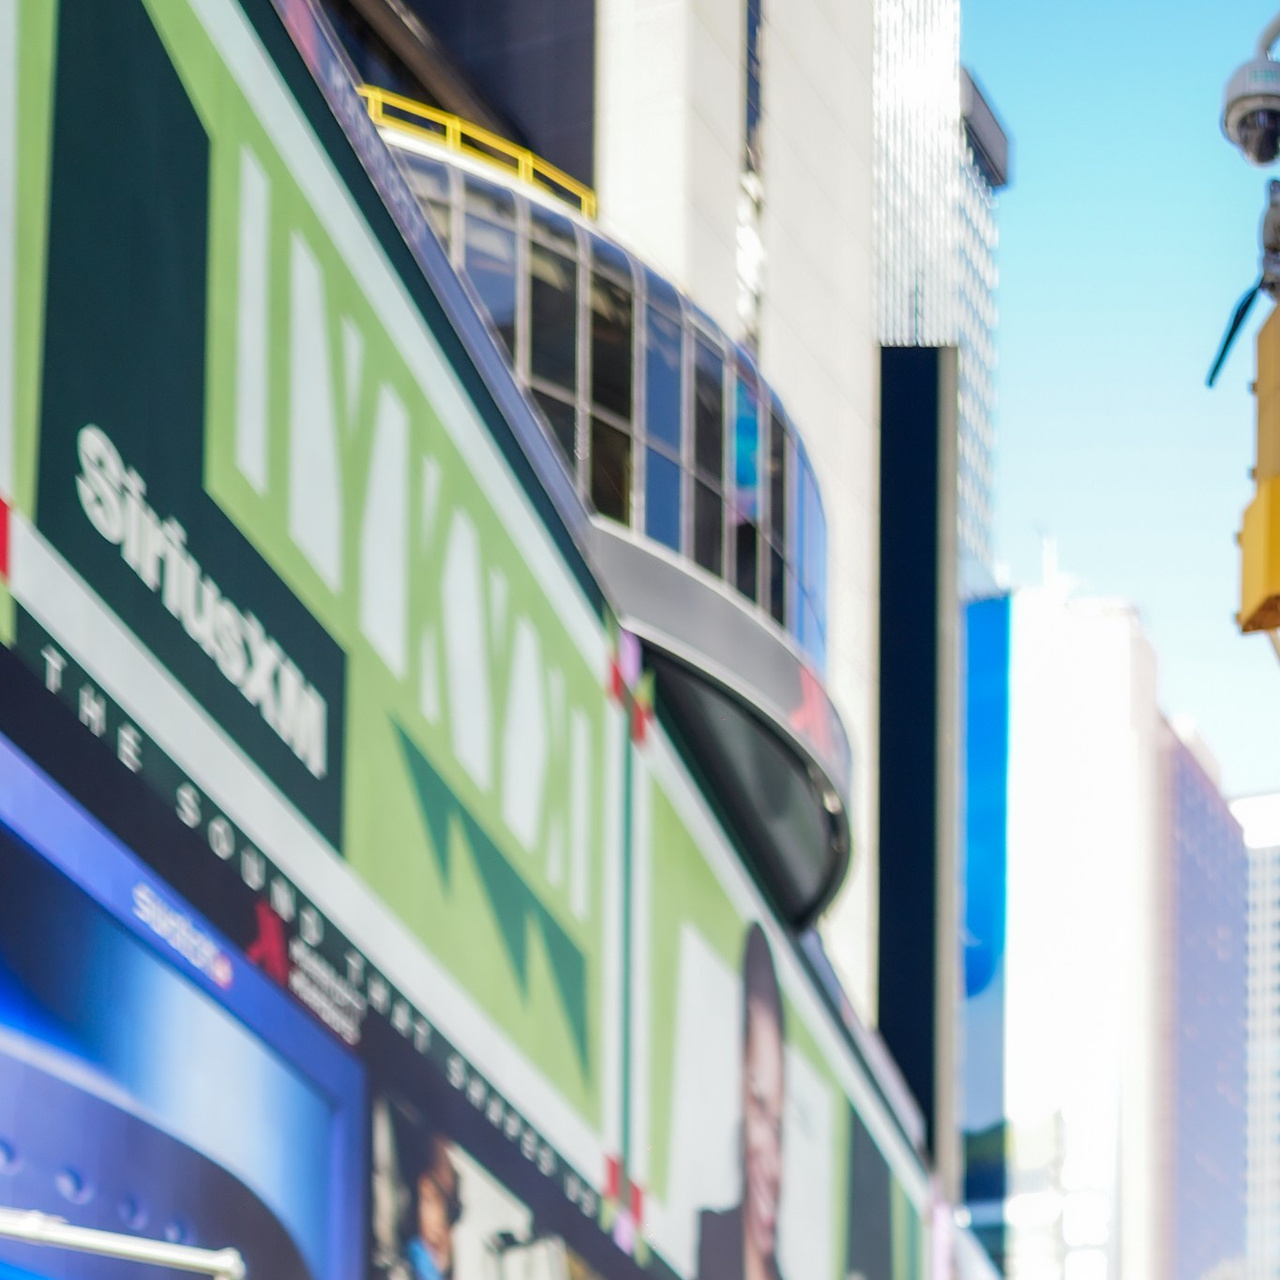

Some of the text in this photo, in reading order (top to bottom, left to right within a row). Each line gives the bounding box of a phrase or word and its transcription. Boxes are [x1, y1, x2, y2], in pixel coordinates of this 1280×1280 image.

[75, 423, 329, 780] SiriusXM
[40, 646, 143, 773] THE
[175, 785, 325, 948] SOUND
[344, 950, 432, 1055] THAT
[445, 1061, 557, 1176] SHAPES
